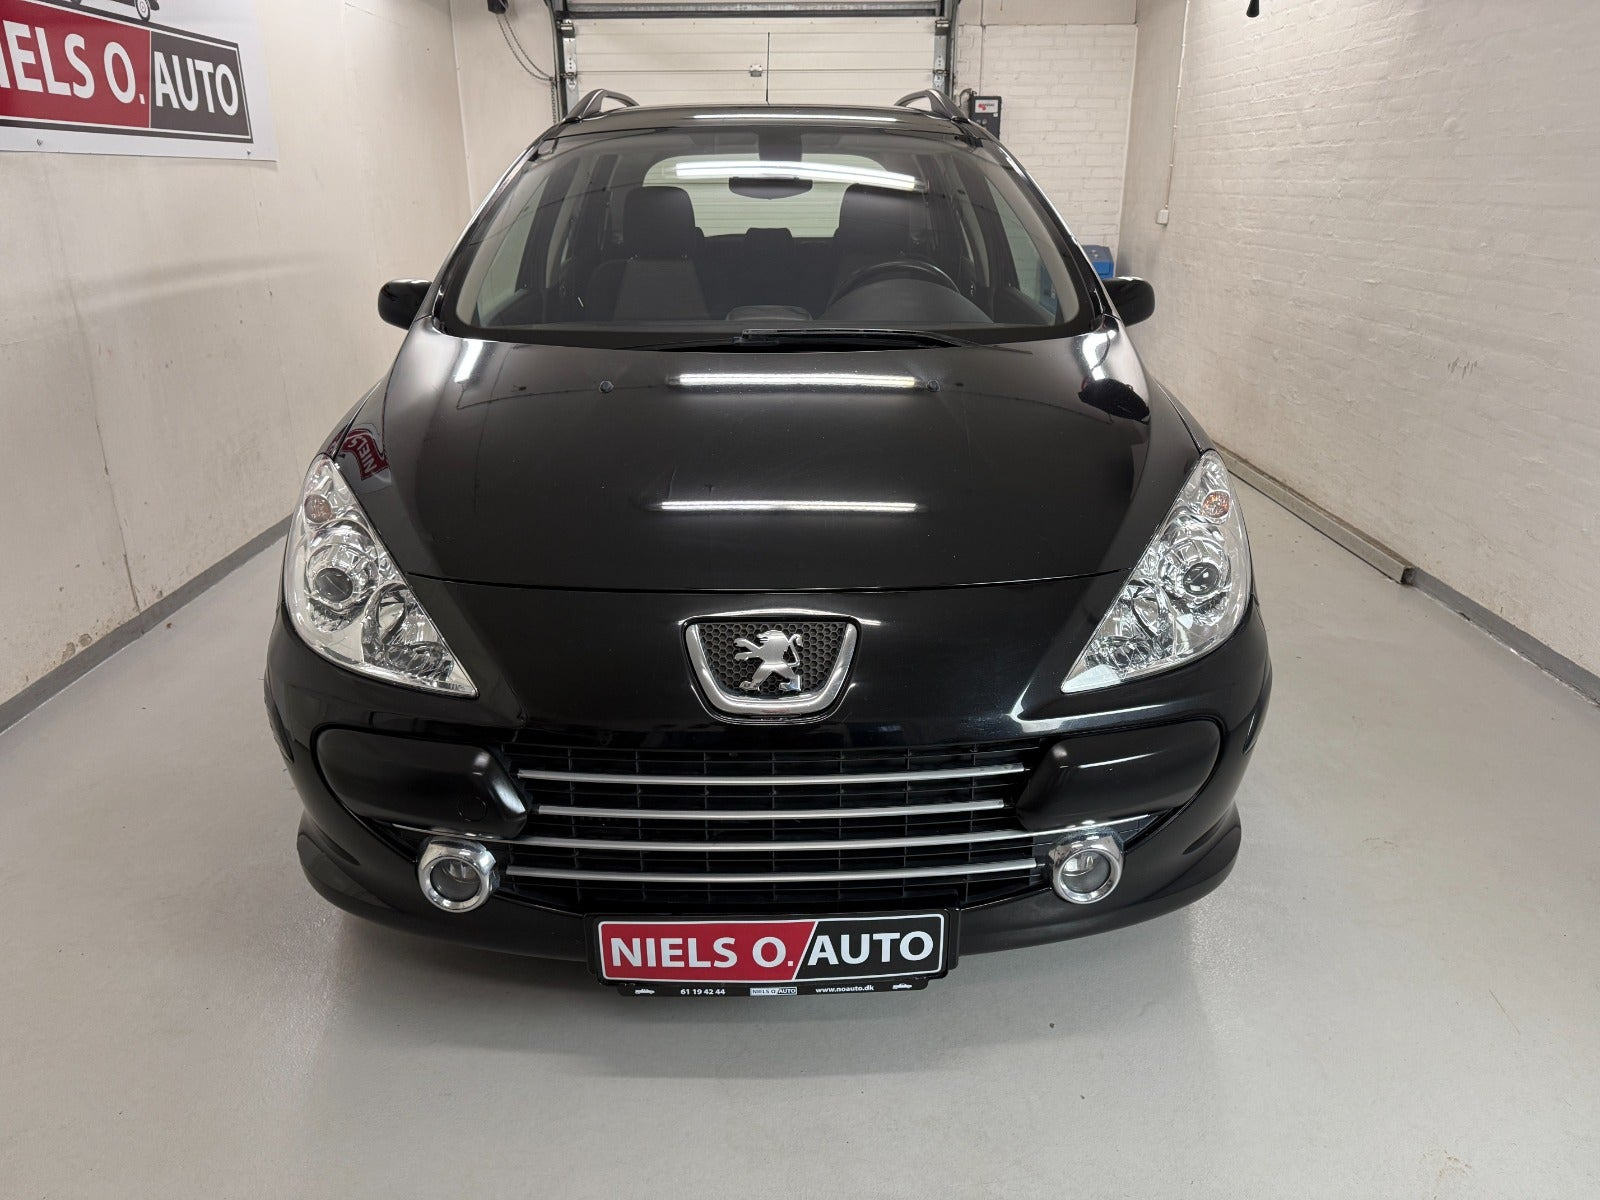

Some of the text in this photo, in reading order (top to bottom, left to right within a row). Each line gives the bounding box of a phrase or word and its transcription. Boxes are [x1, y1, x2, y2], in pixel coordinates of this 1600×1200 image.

[104, 41, 146, 105] O.
[154, 51, 239, 116] AUTO
[348, 435, 377, 473] NIELS
[610, 931, 934, 968] NIELS O. AUTO
[815, 985, 875, 993] www.noauto.dk
